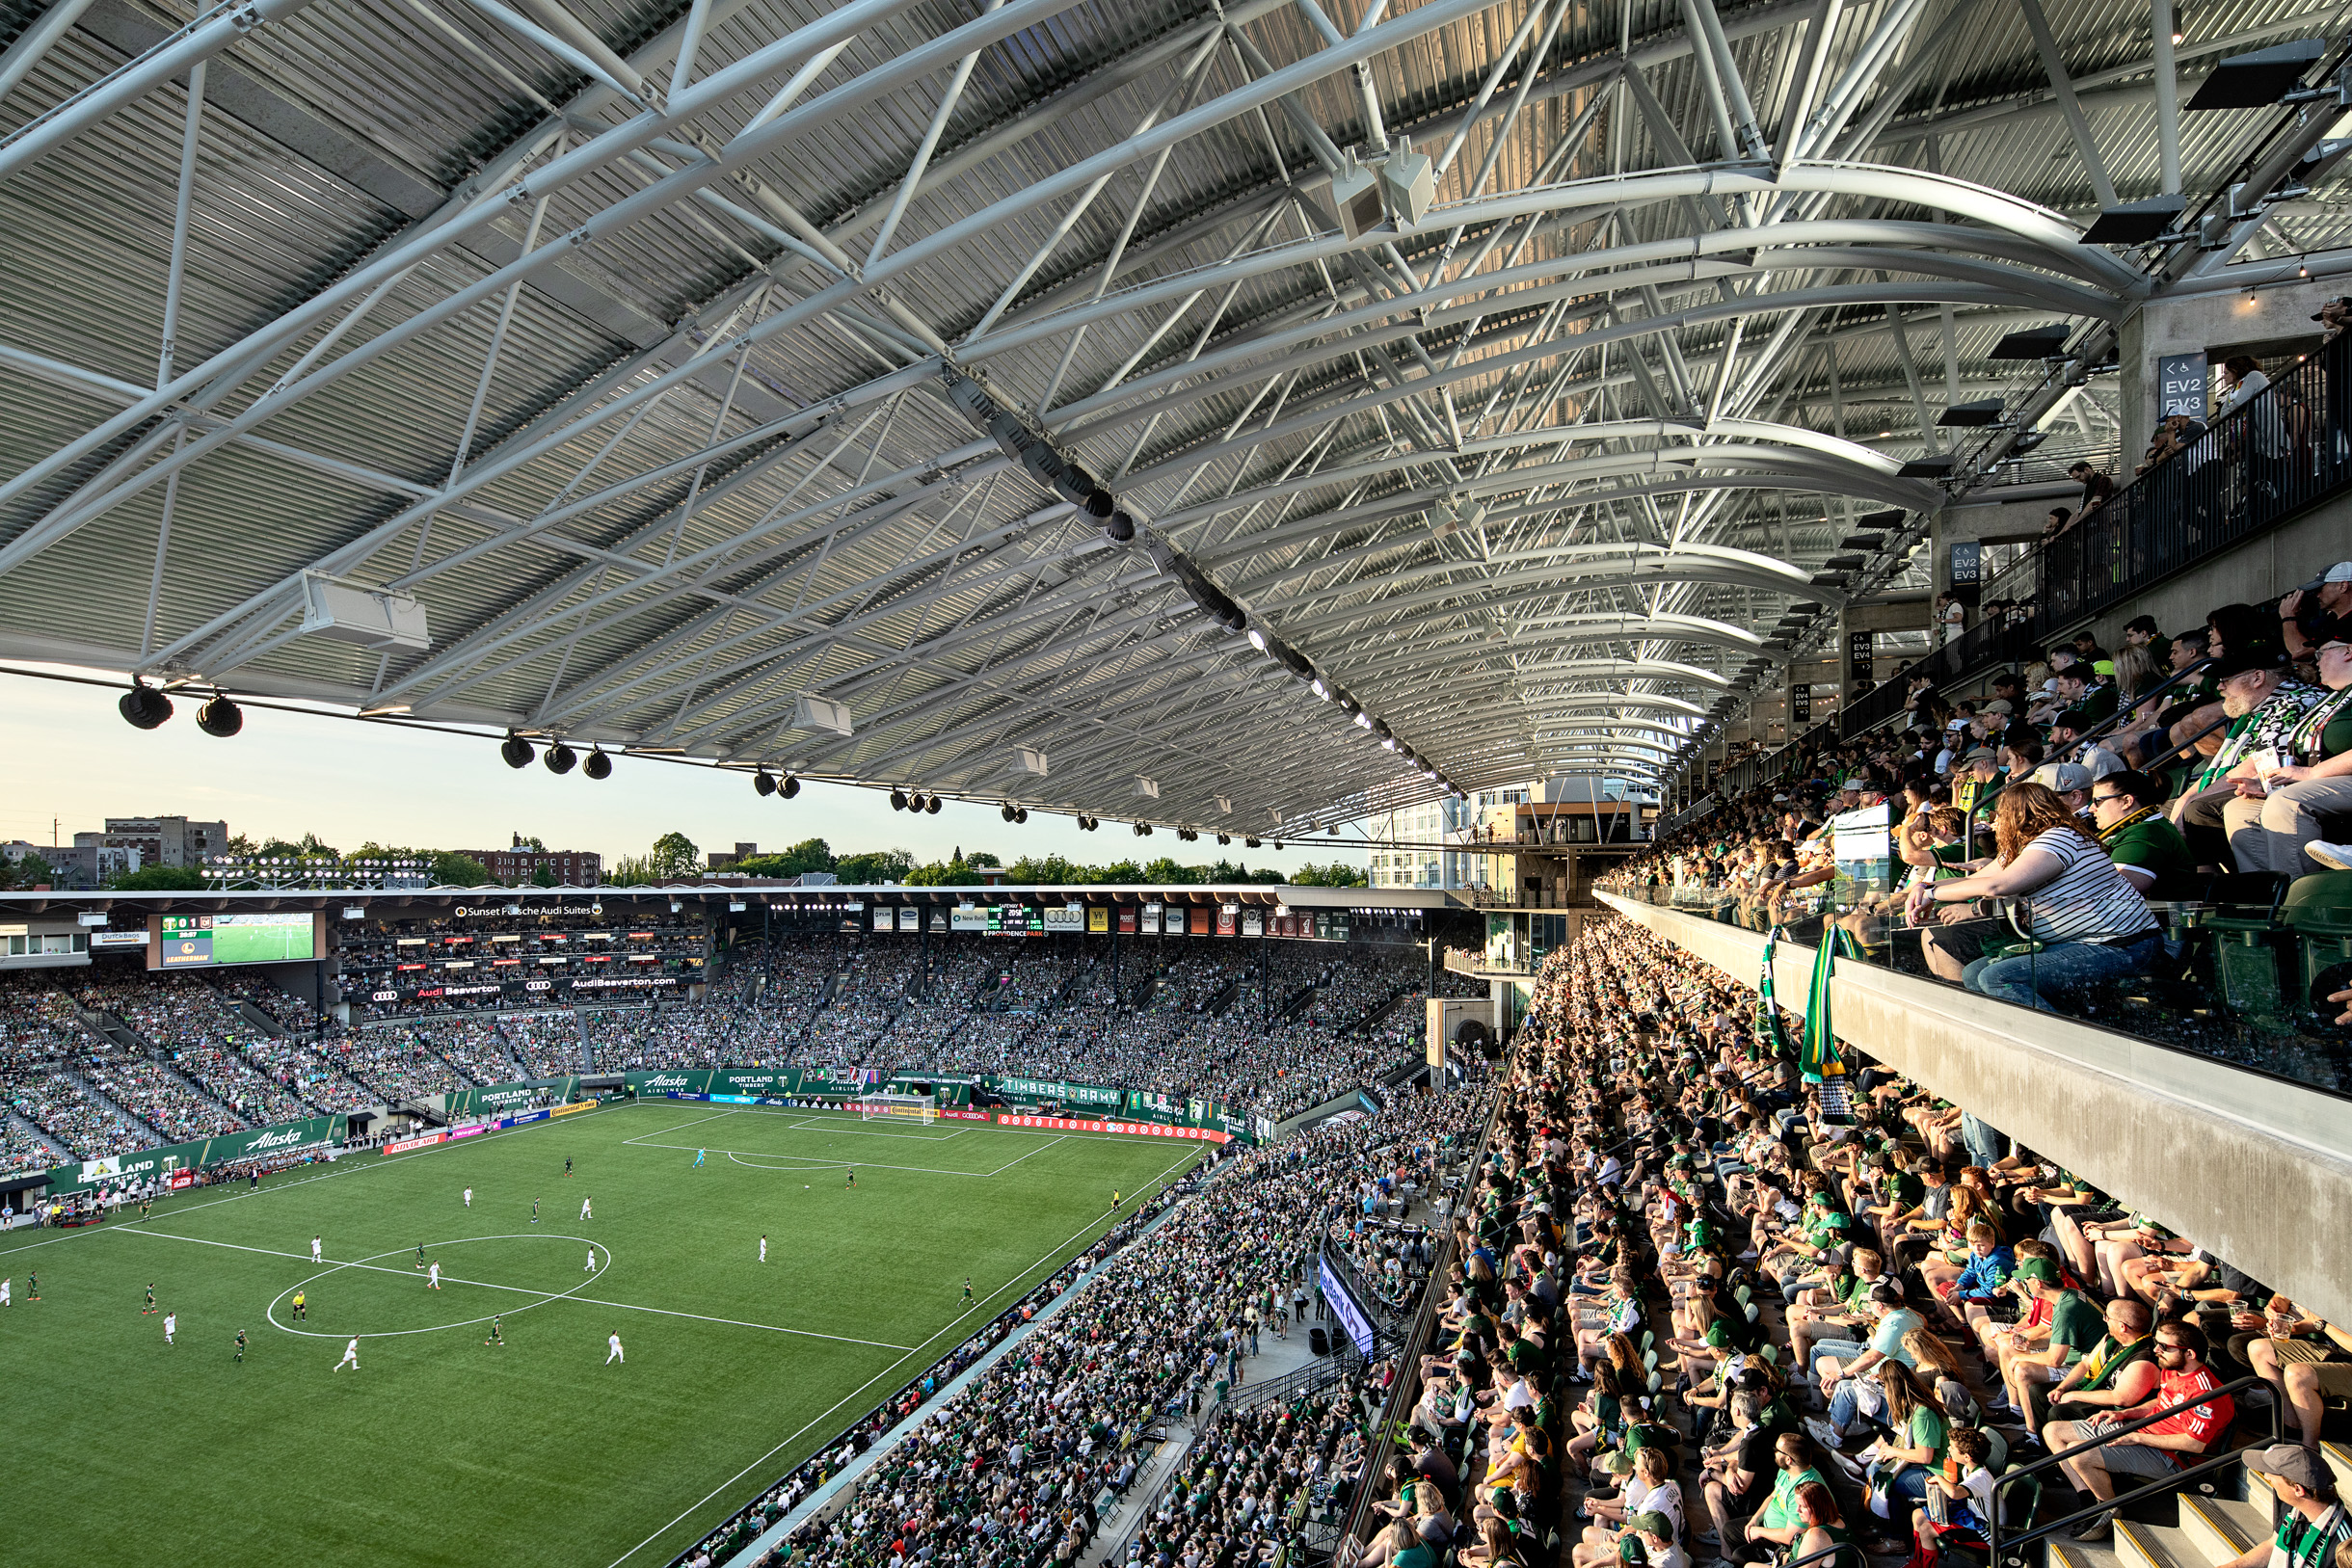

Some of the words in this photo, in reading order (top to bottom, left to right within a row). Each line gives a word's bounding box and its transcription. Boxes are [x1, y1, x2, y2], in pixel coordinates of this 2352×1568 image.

[2166, 378, 2201, 394] EV2
[2166, 396, 2201, 411] EV3
[1955, 558, 1976, 568] EV2
[1955, 571, 1976, 579] EV3
[468, 907, 500, 917] Sunset
[541, 906, 562, 915] Audi
[564, 906, 591, 915] Suites
[178, 918, 187, 928] 0
[190, 917, 196, 927] 1
[166, 954, 209, 963] LEATHERMAN
[572, 978, 676, 988] AudiBeaverton.com
[417, 988, 442, 997] Audi
[445, 985, 500, 995] Beaverton
[644, 1075, 688, 1087] Alaska
[482, 1089, 531, 1103] PORTLAND
[1006, 1078, 1065, 1098] TIMBERS
[1080, 1089, 1118, 1103] ARMY
[551, 1103, 580, 1116] Continental
[893, 1105, 922, 1115] Continental
[1153, 1113, 1182, 1124] AIRLIES
[246, 1129, 302, 1152] Alaska
[391, 1135, 440, 1154] ADVOCARE
[1666, 1488, 1679, 1502] CHARA
